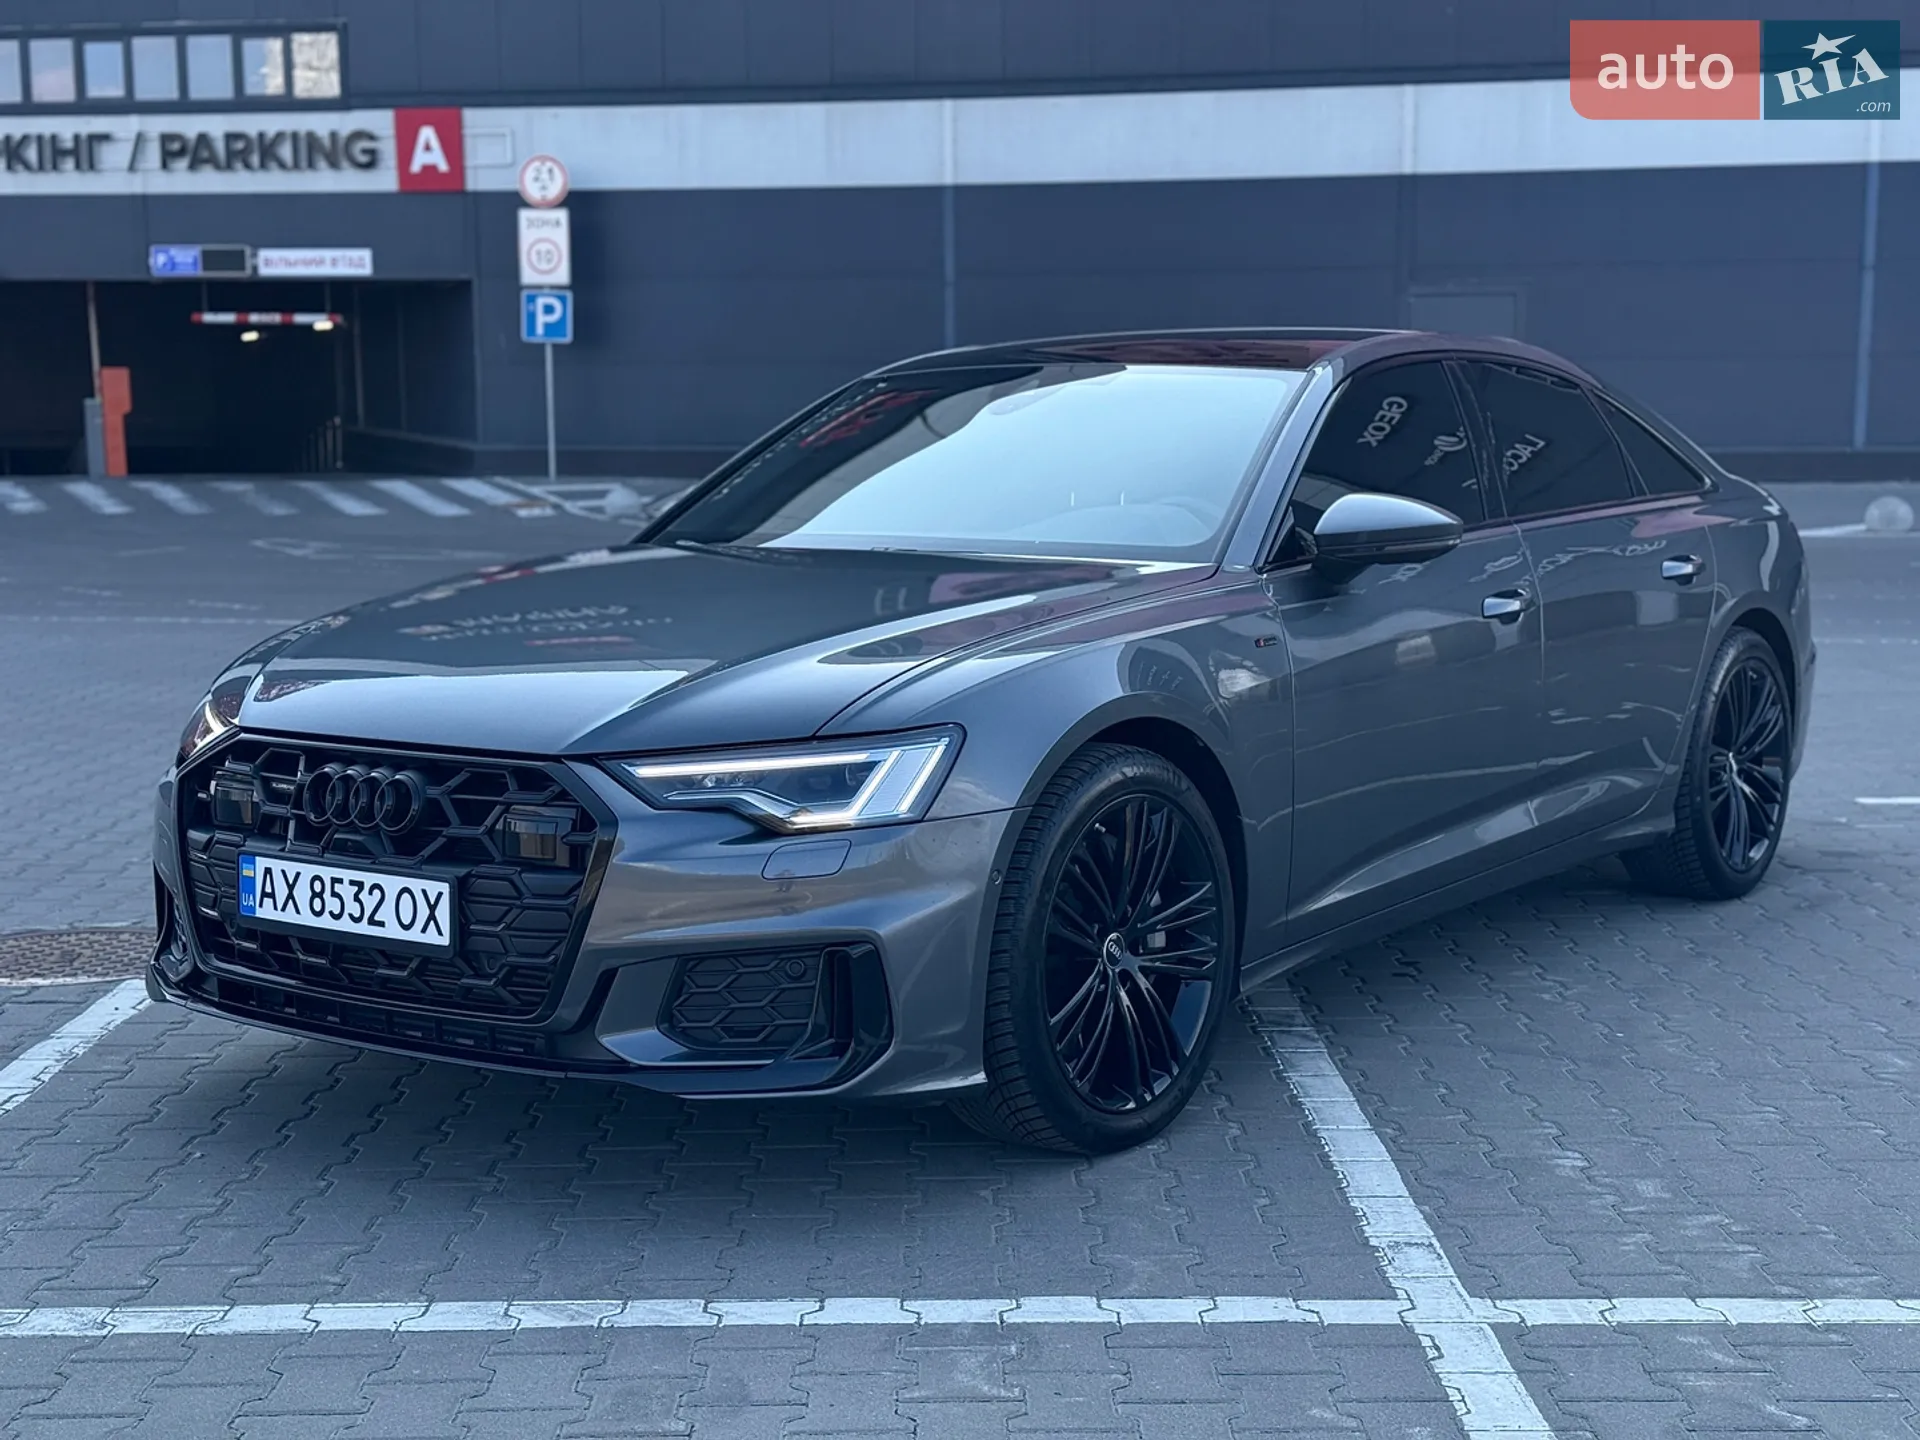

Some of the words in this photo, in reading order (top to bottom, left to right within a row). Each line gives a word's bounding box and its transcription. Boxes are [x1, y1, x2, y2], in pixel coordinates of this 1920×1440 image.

[0, 132, 113, 172] КІНГ
[159, 130, 379, 172] PARKING
[534, 249, 555, 266] 10
[242, 894, 255, 908] UA
[258, 866, 302, 916] AX
[309, 874, 387, 929] 8532
[394, 886, 444, 938] OX
